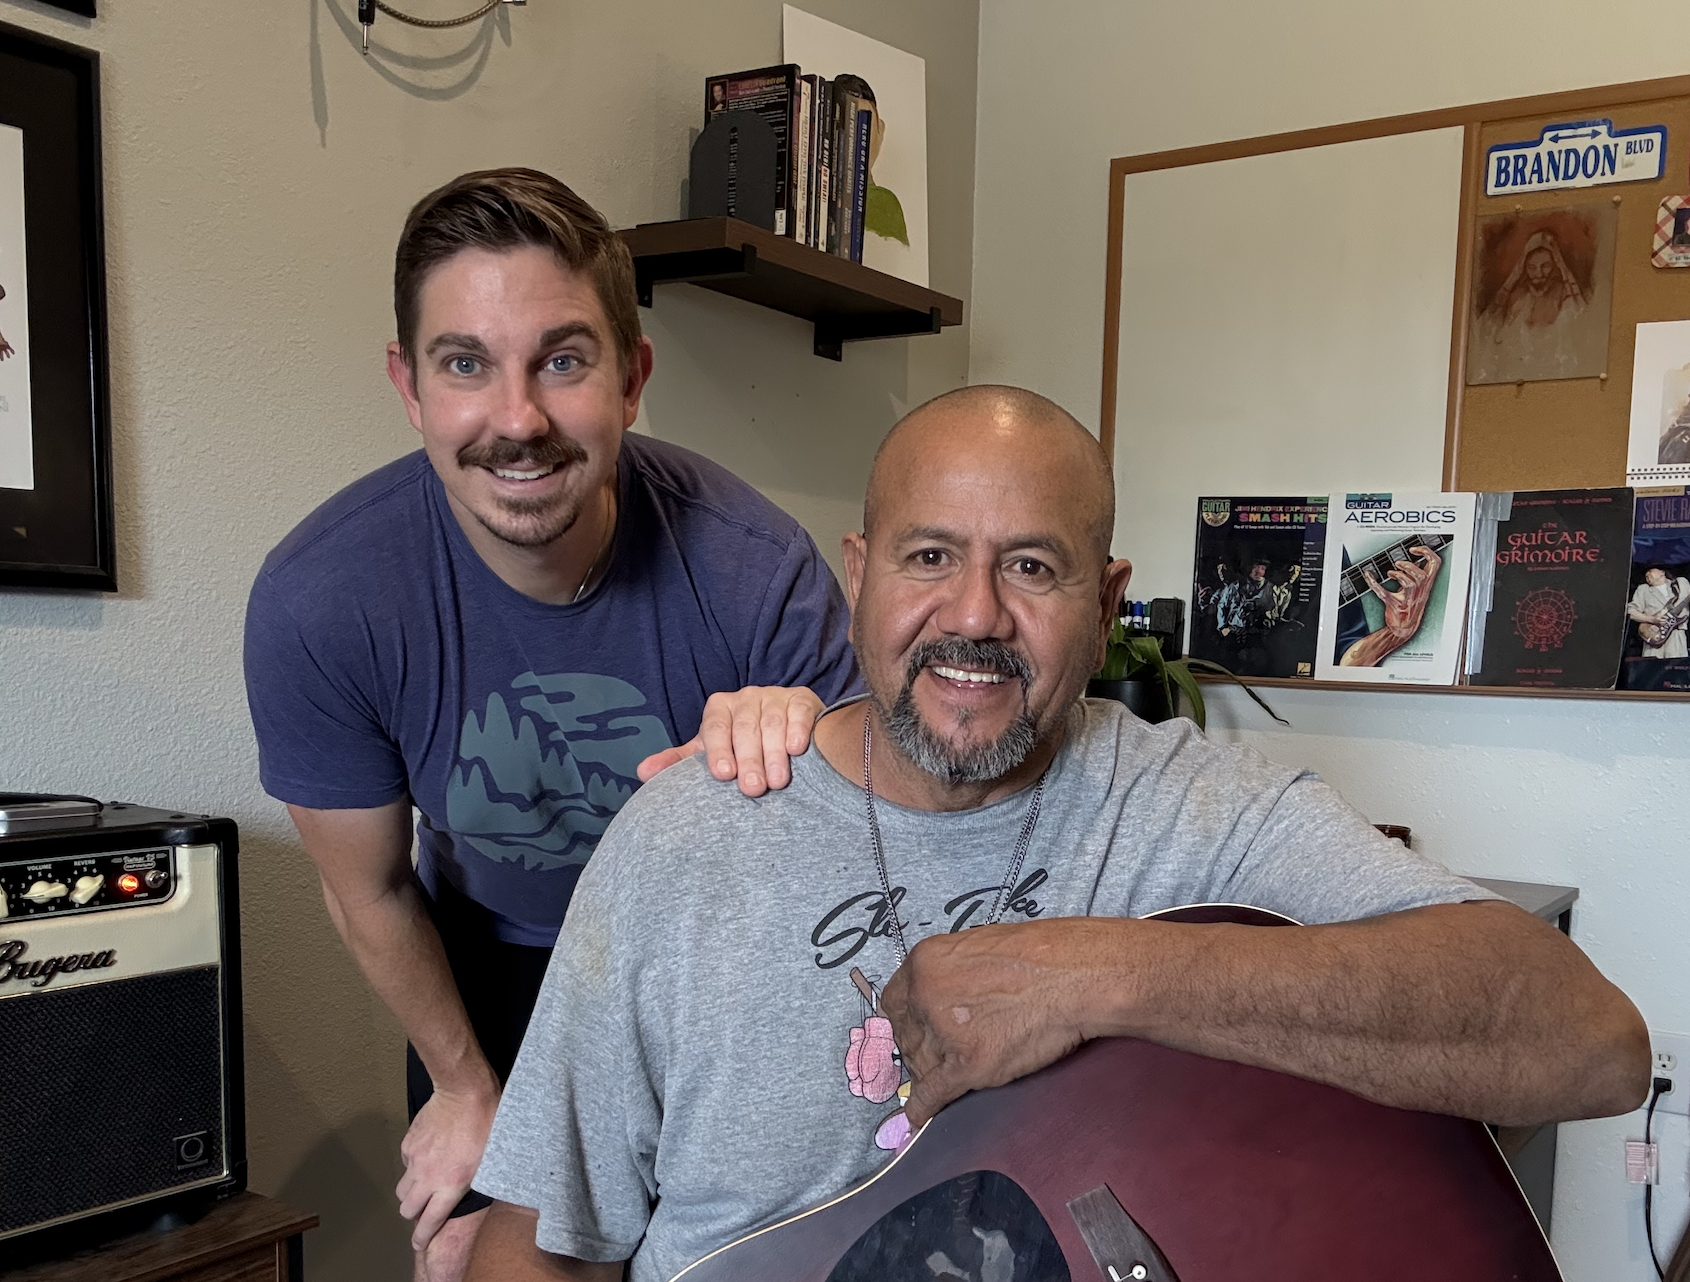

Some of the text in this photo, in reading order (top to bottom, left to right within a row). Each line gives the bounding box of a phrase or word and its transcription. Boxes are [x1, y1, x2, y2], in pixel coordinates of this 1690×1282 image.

[1494, 138, 1654, 188] BRANDON BLVD
[1201, 501, 1231, 512] GUITAR
[1643, 498, 1677, 522] STEVIE
[1239, 513, 1328, 523] SMASH HITS
[1344, 510, 1456, 523] AEROBICS
[0, 939, 117, 987] Bugera
